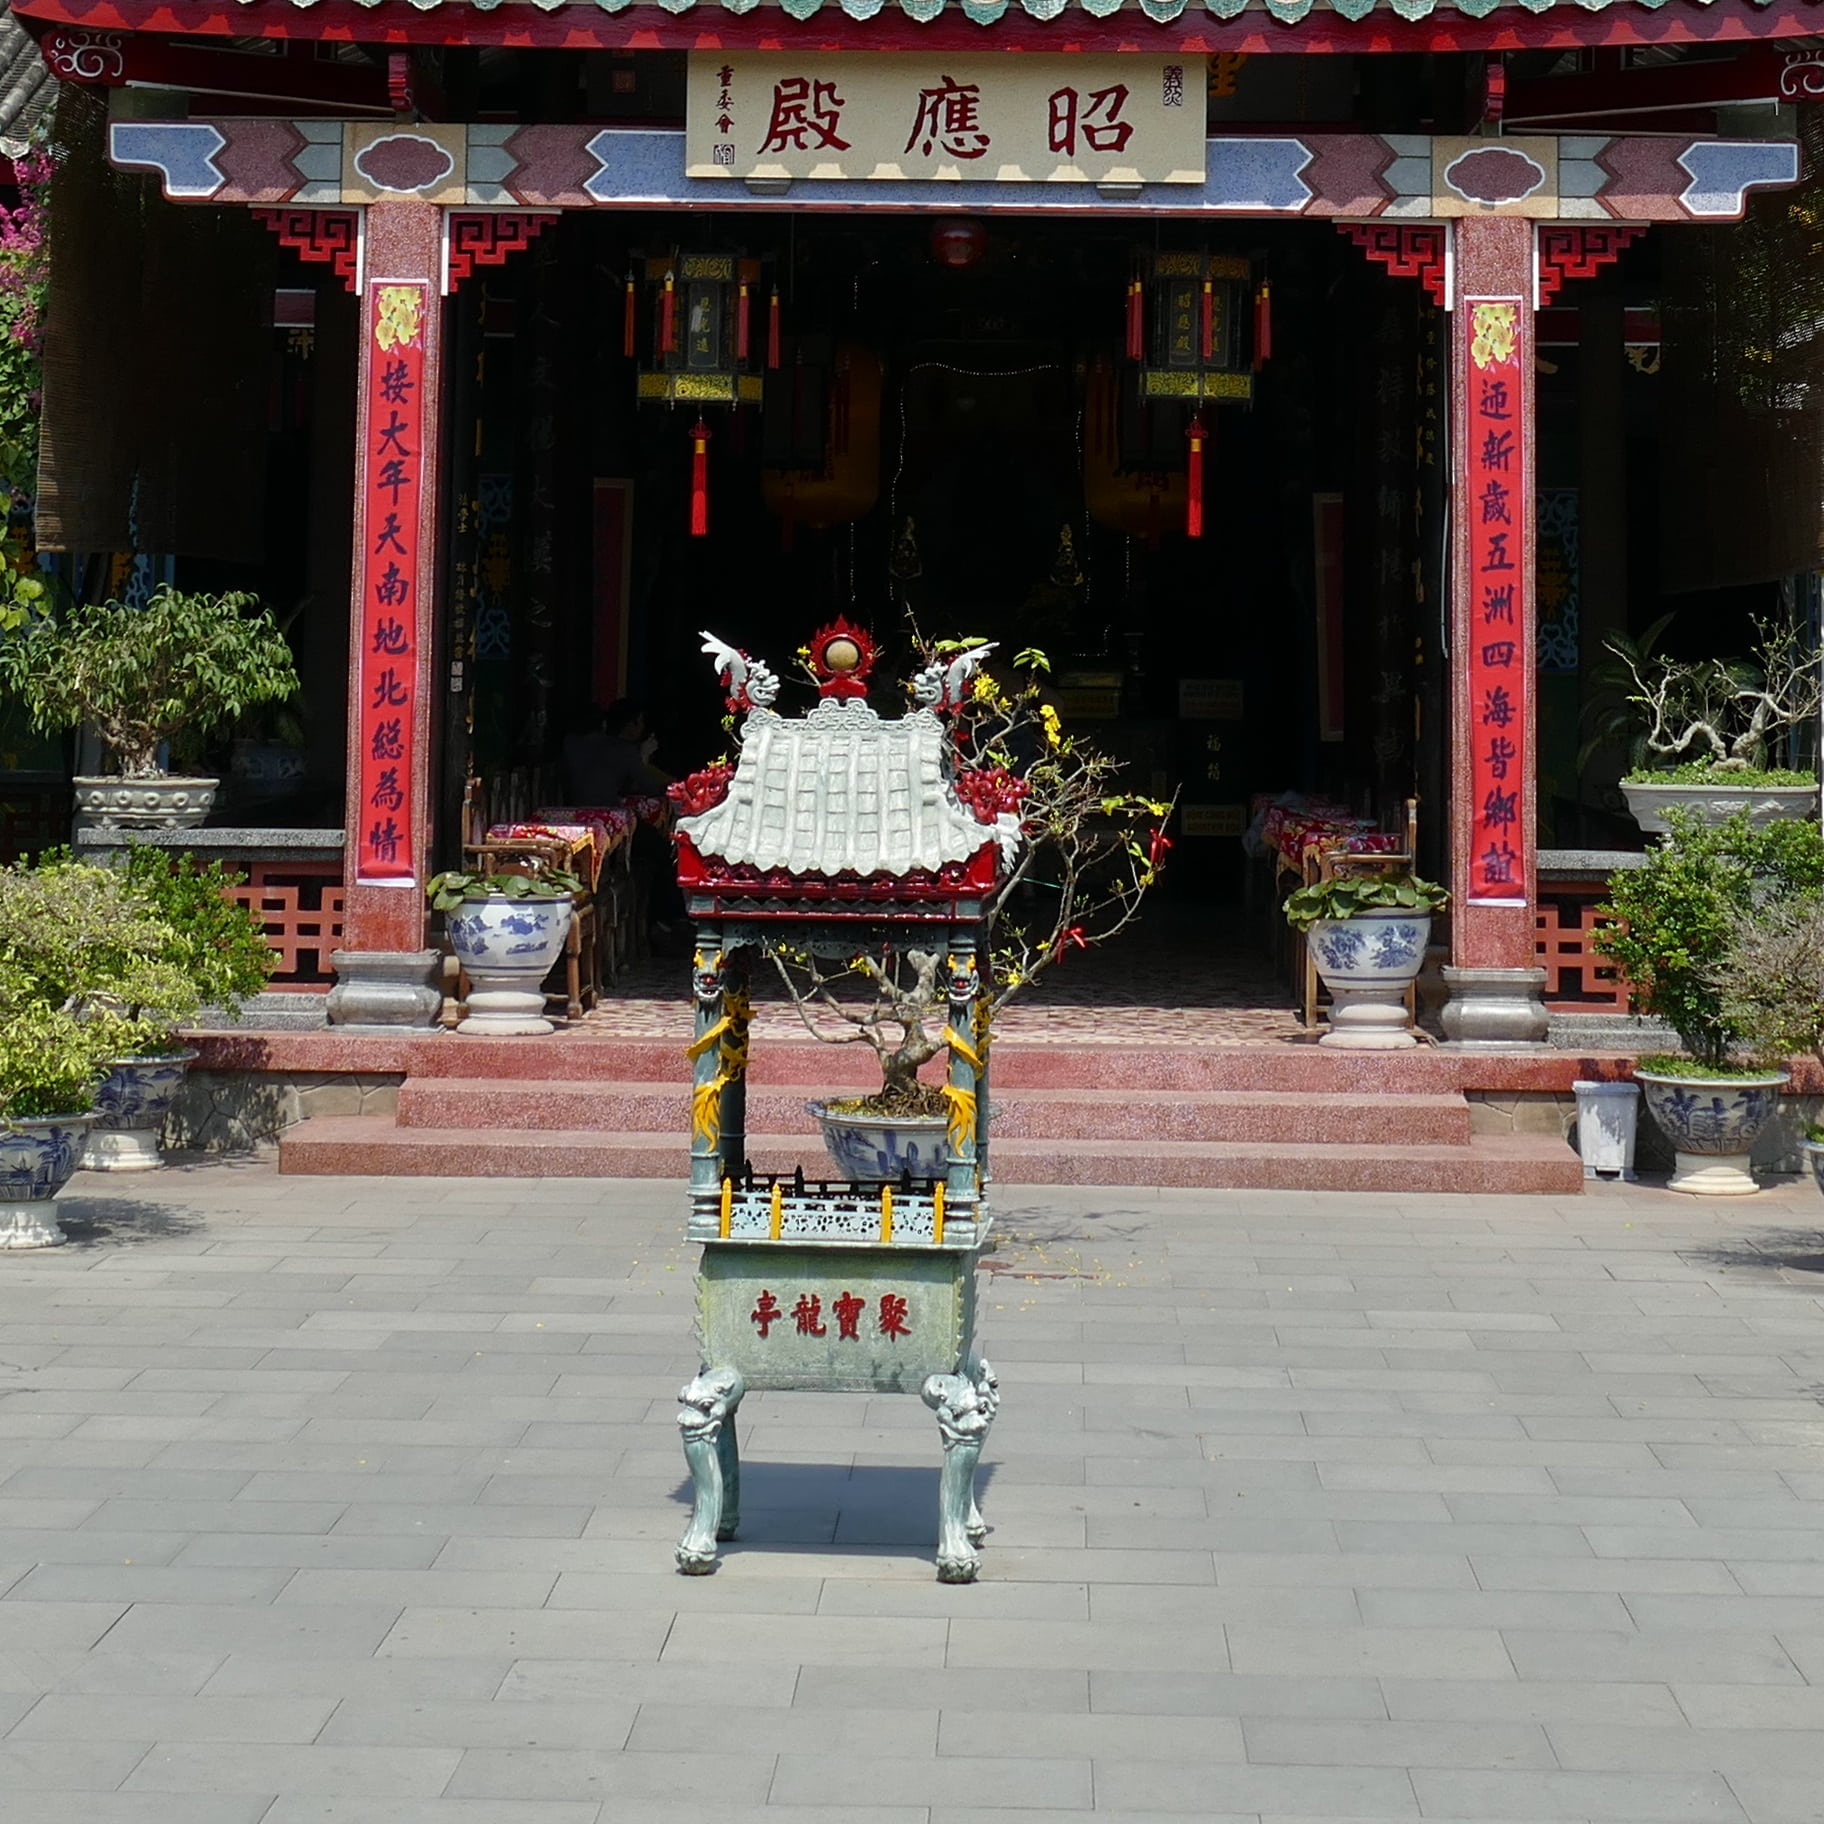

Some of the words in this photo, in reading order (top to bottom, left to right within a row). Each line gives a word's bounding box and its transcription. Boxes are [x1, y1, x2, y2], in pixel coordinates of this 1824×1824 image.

[756, 75, 1135, 159] 昭應殿
[751, 1289, 913, 1343] 聚寶龍亭
